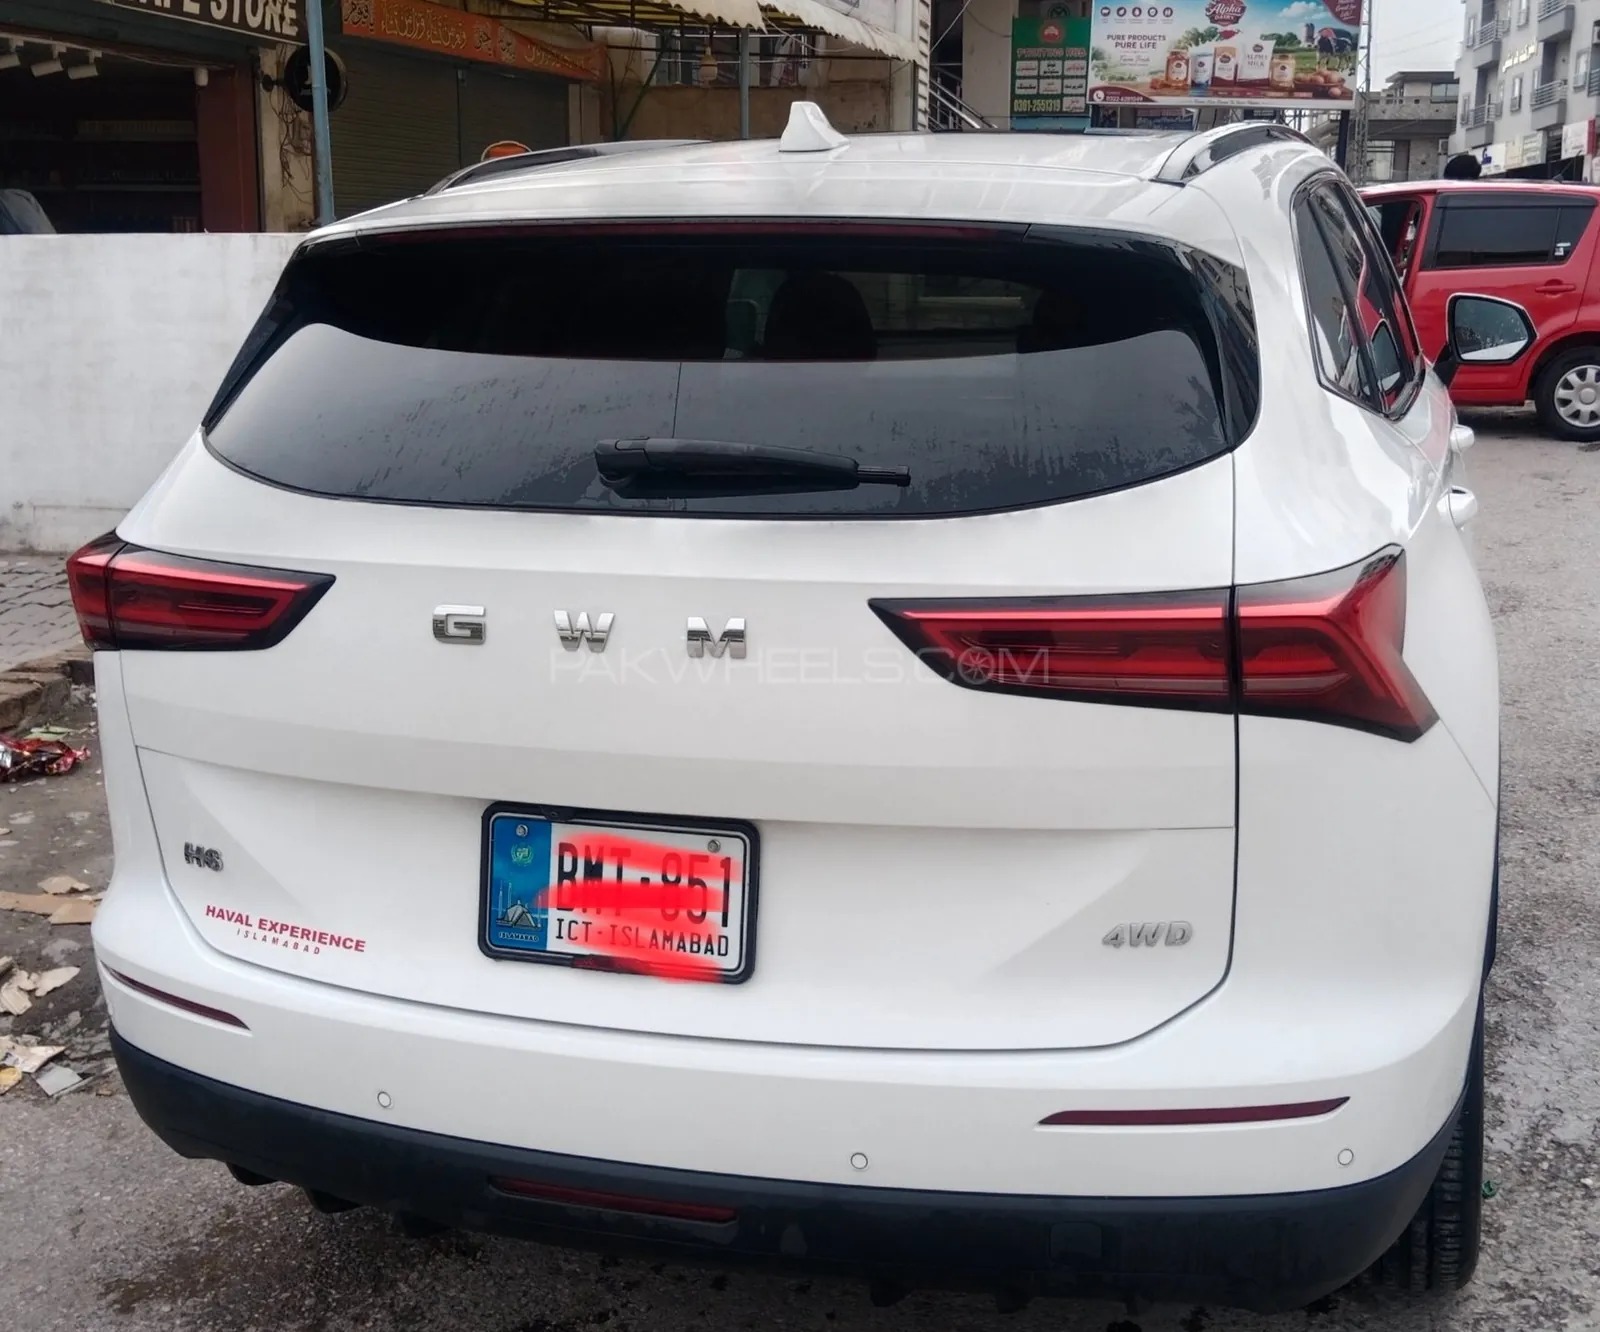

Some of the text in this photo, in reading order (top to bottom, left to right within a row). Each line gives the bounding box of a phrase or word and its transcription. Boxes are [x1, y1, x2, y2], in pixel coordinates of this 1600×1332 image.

[1206, 3, 1242, 16] Alpha
[1115, 41, 1137, 49] PURE
[205, 904, 366, 952] HAVAL EXPERIENCE
[236, 927, 321, 955] ISLAMABAD
[1101, 920, 1194, 949] 4WD
